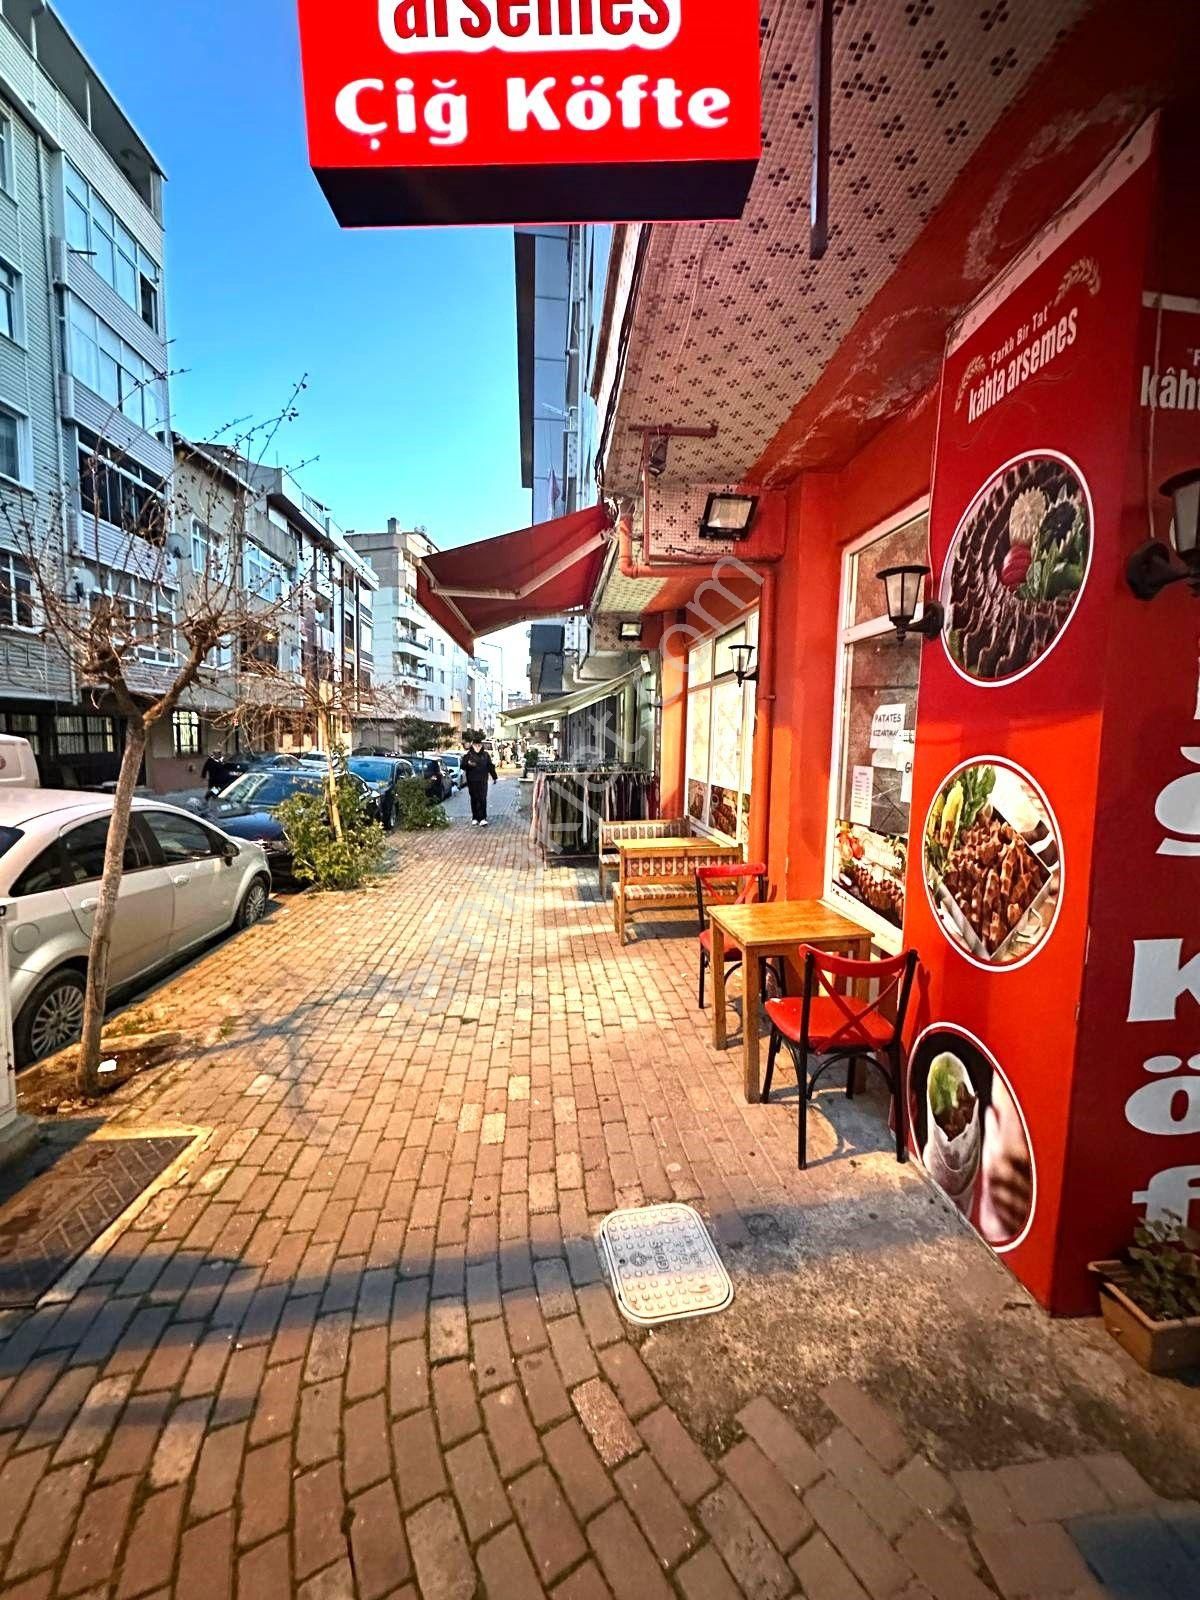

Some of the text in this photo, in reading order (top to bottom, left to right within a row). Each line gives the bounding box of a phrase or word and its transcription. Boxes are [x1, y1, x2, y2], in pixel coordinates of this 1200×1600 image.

[334, 74, 732, 151] Çiğ Köfte
[1007, 307, 1078, 393] arsemes
[1017, 324, 1030, 347] Bir
[1140, 365, 1200, 411] kâh
[875, 713, 902, 724] PATATES
